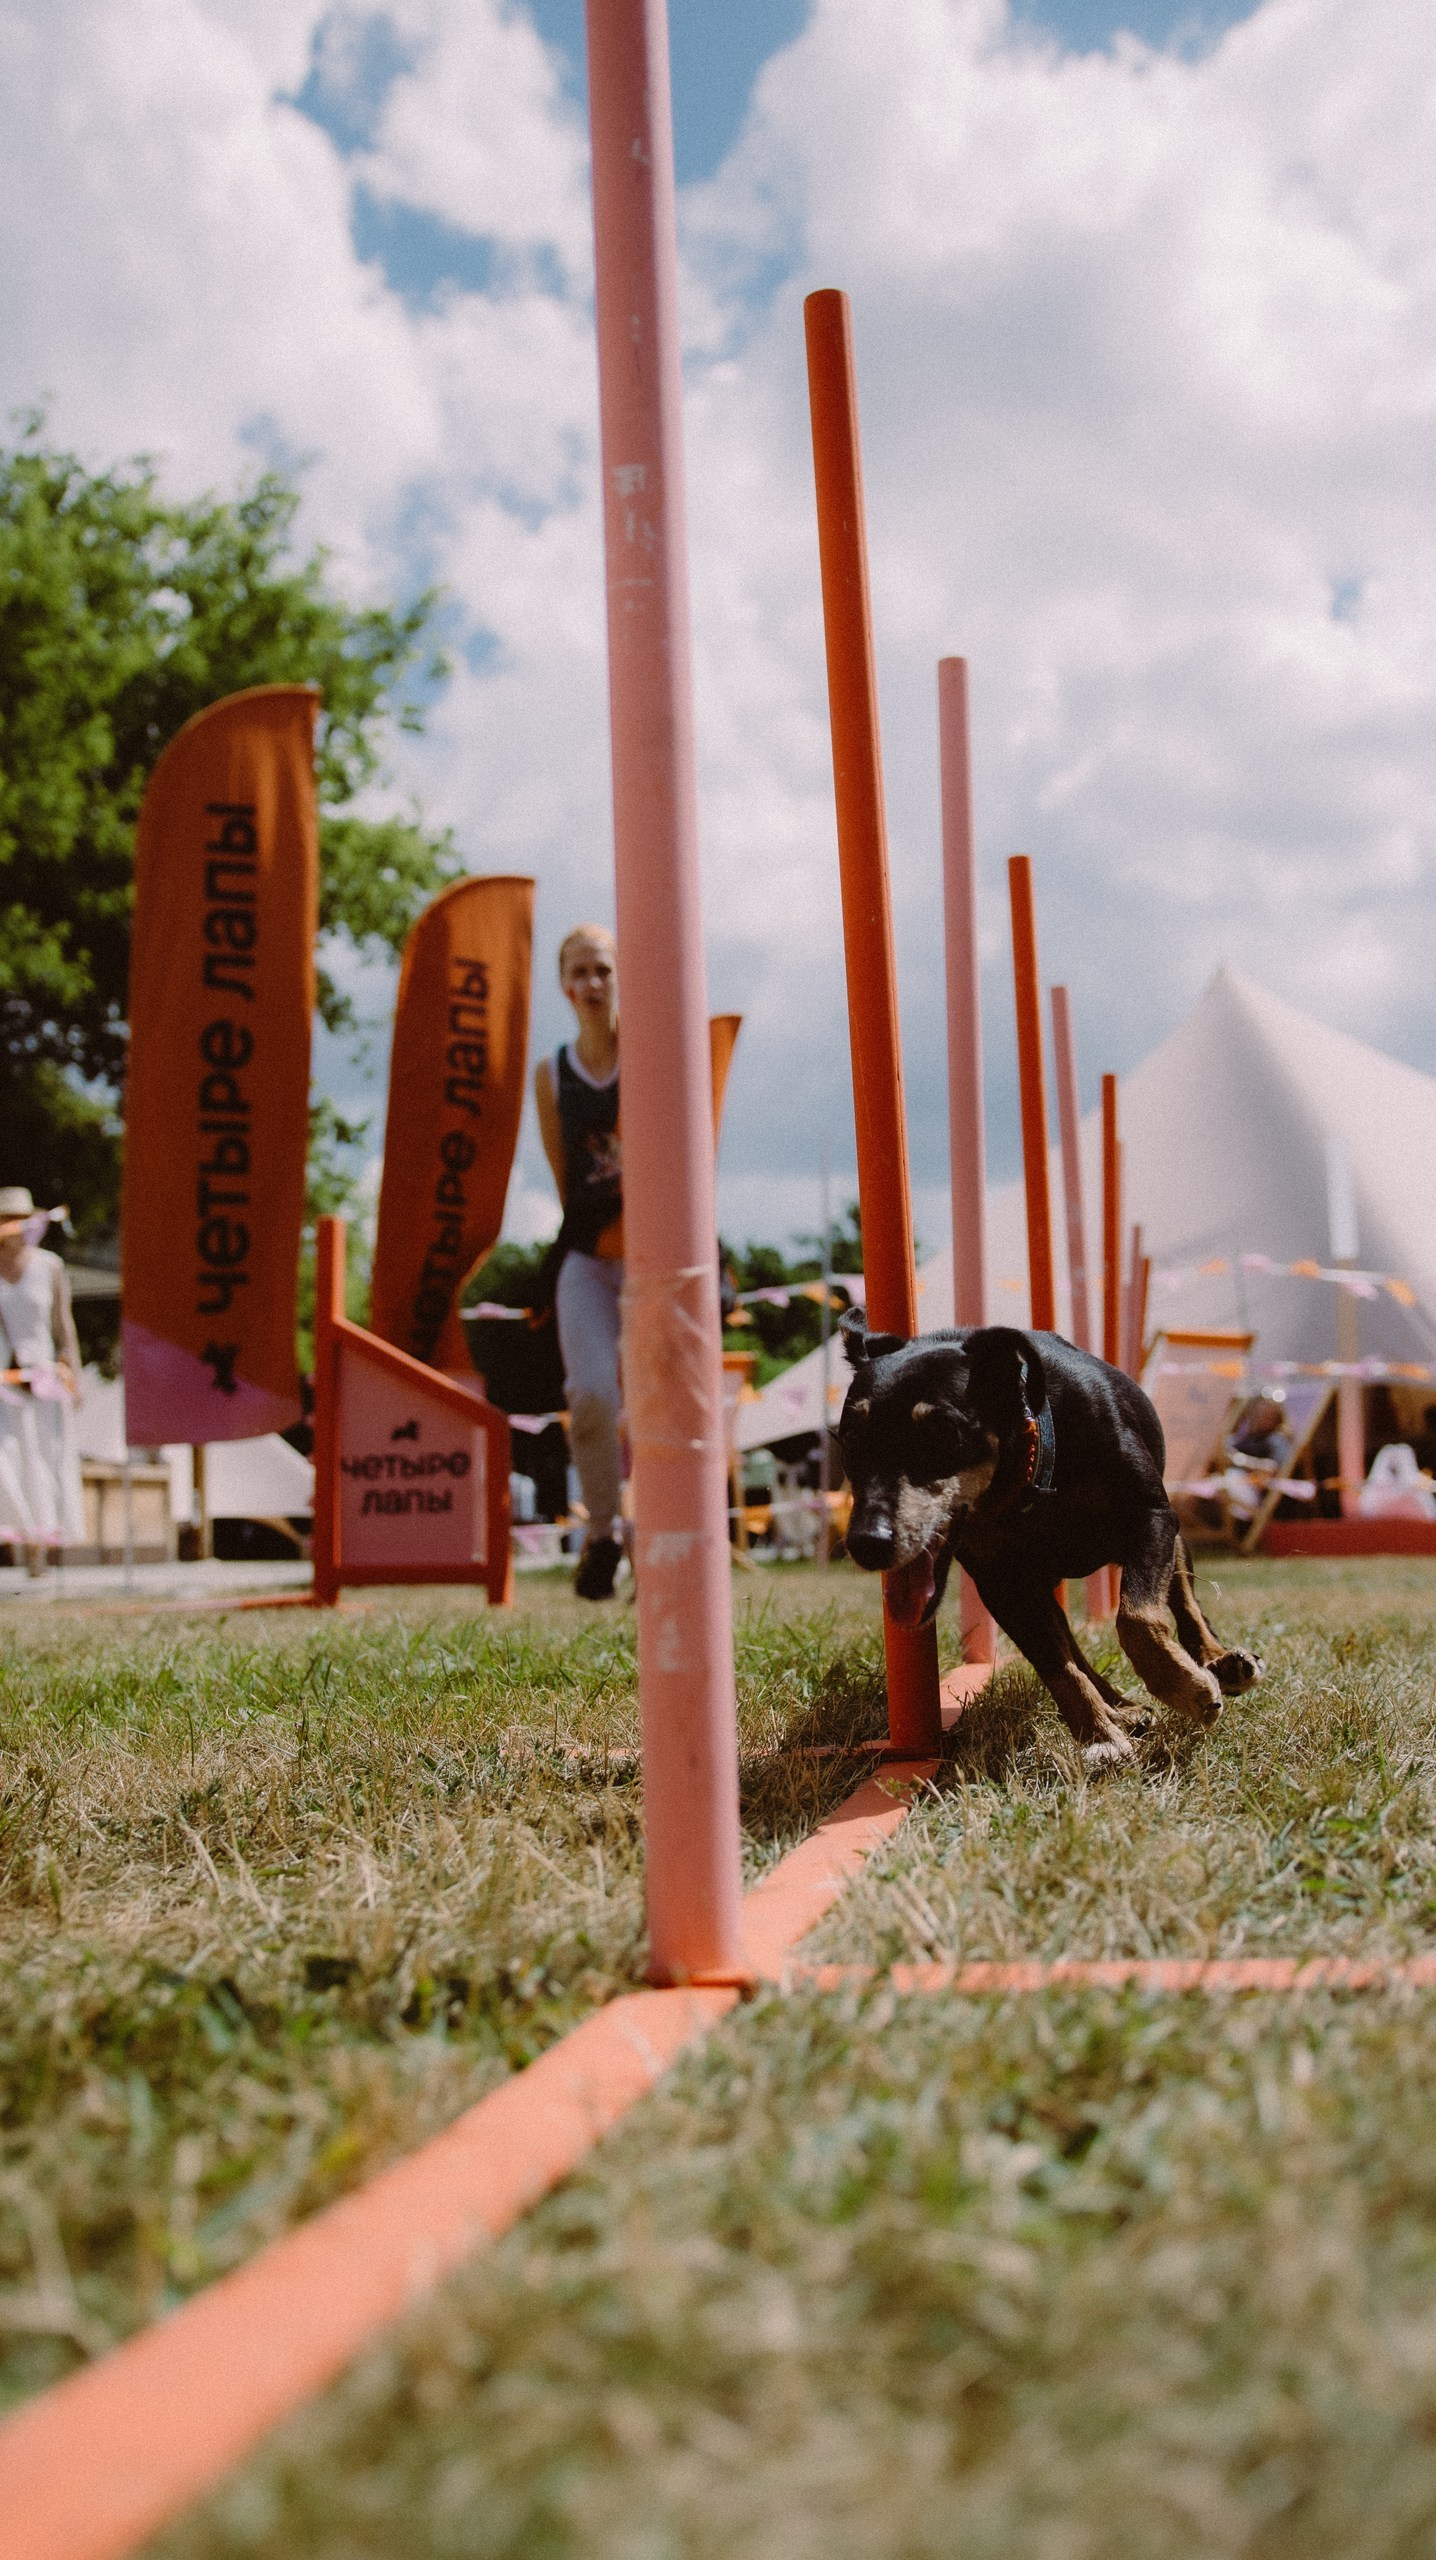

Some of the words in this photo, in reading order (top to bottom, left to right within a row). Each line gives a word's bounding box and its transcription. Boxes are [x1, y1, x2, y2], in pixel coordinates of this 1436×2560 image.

[202, 802, 259, 1001] лапы
[444, 956, 490, 1119] лапы
[196, 1018, 255, 1316] четыре
